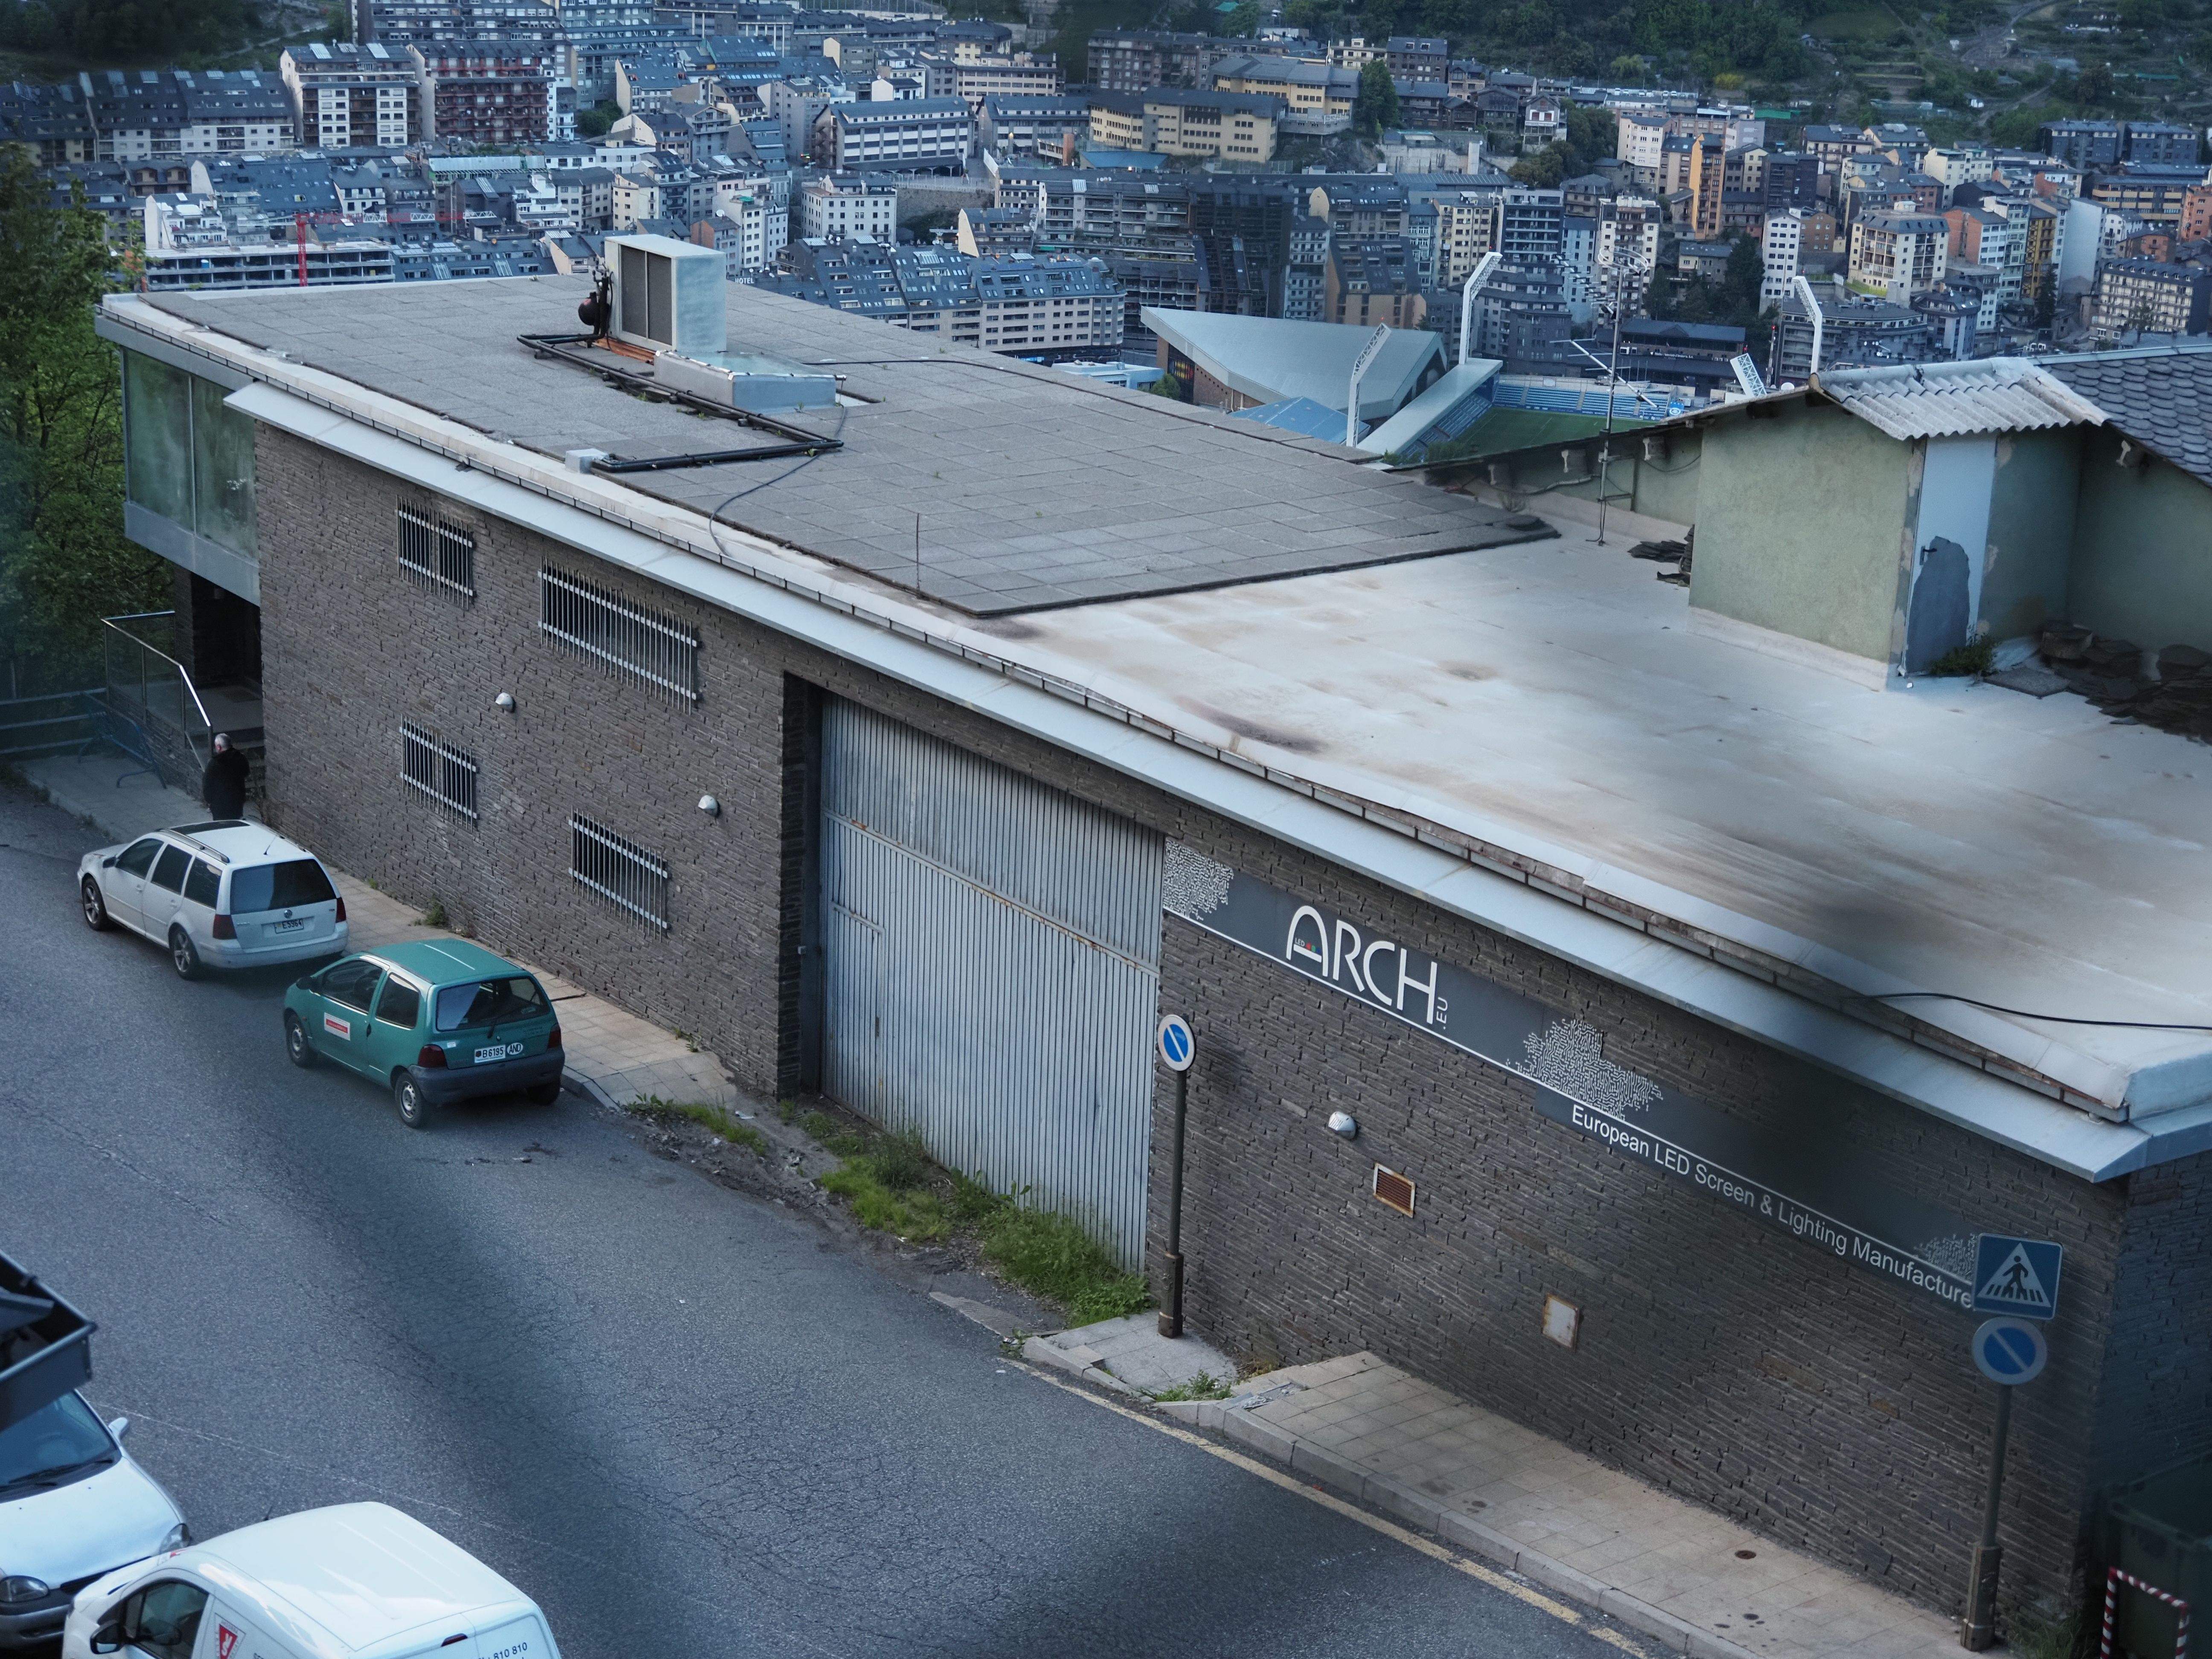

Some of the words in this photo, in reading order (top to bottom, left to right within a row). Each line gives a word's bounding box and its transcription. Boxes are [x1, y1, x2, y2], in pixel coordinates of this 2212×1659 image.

[1295, 937, 1305, 947] LED
[1286, 905, 1438, 1025] ARCH
[509, 1044, 521, 1054] AND
[1572, 1104, 1649, 1157] European
[1655, 1144, 1690, 1175] LED
[1695, 1164, 1755, 1207] Screen
[1760, 1195, 1773, 1217] &
[1778, 1202, 1847, 1255] Lighting
[494, 1649, 509, 1659] 810
[512, 1642, 527, 1654] 810
